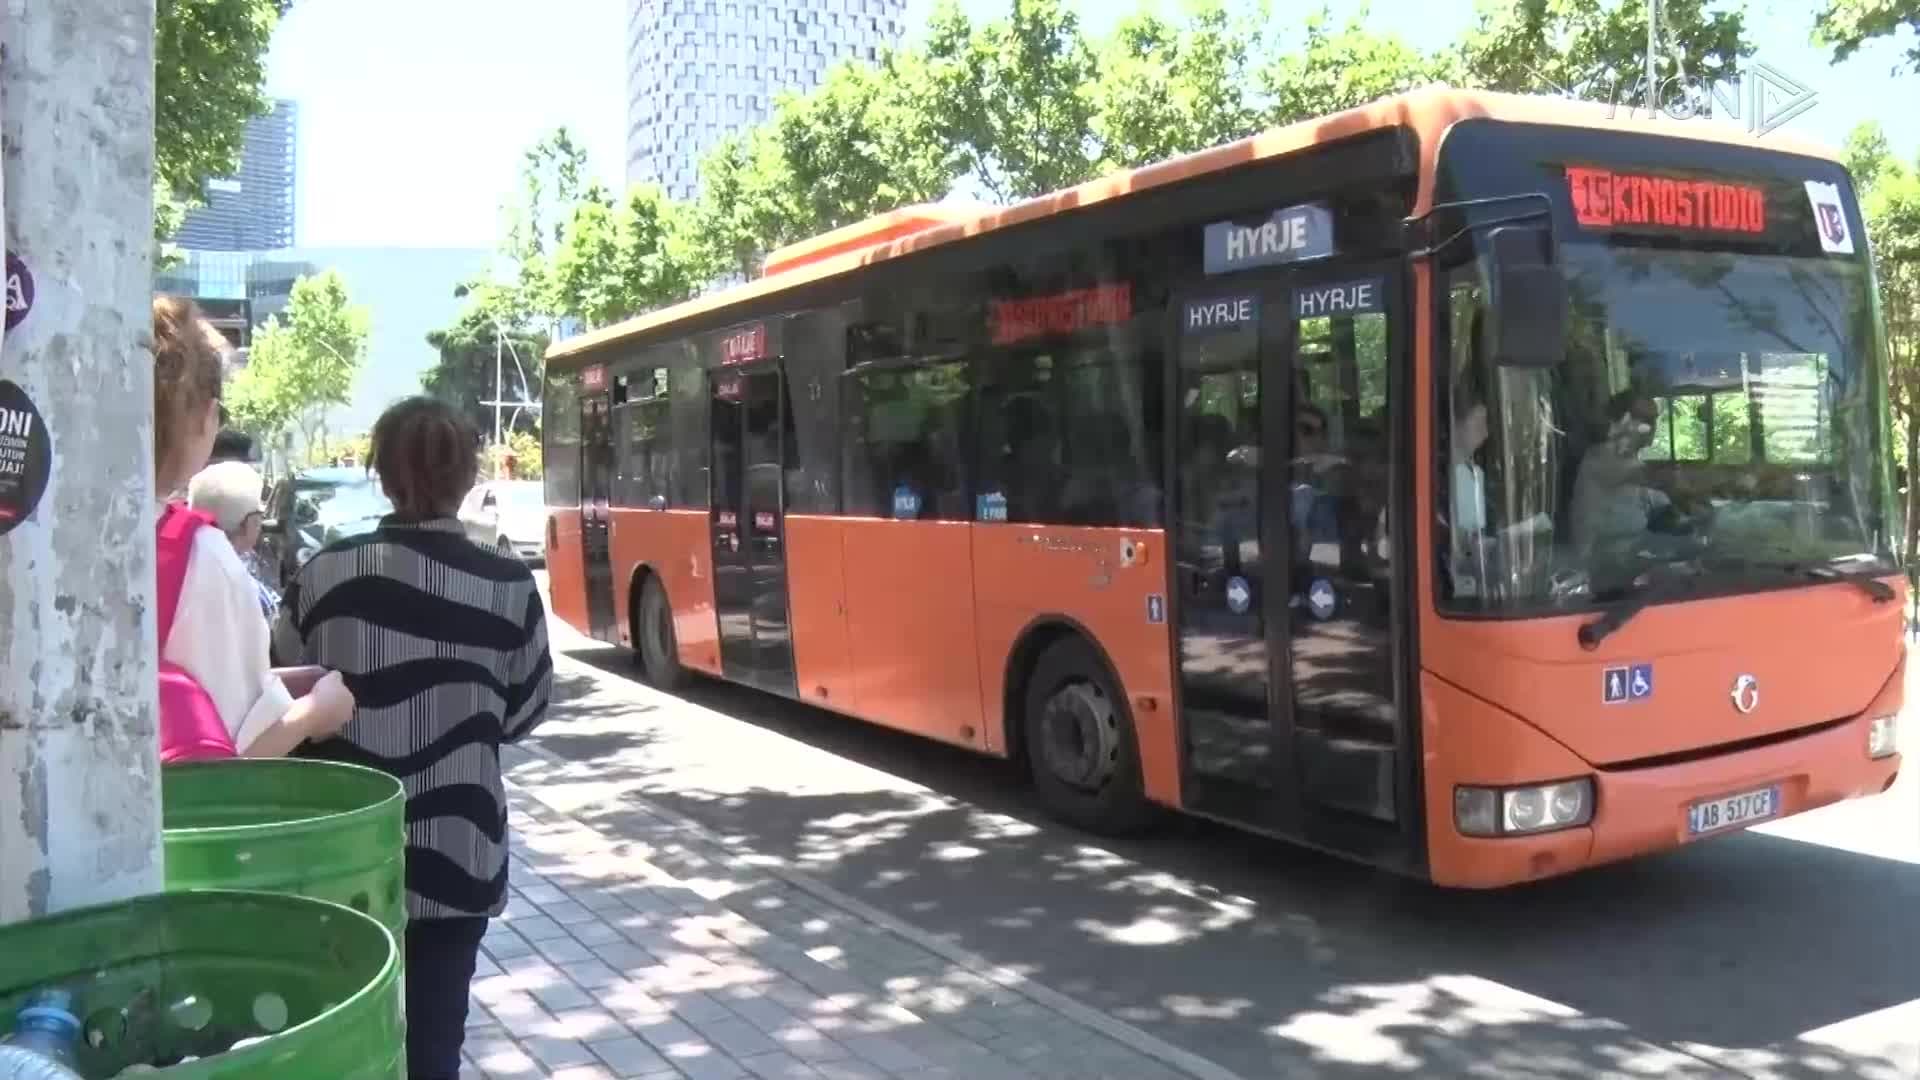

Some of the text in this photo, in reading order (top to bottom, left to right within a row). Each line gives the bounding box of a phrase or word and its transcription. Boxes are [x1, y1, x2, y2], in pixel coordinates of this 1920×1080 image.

[1612, 174, 1765, 232] KINOSTUDIO
[1227, 216, 1307, 261] HYRJE
[1189, 299, 1251, 329] HYRJE
[1300, 284, 1373, 315] HYRJE
[1702, 803, 1720, 828] AB
